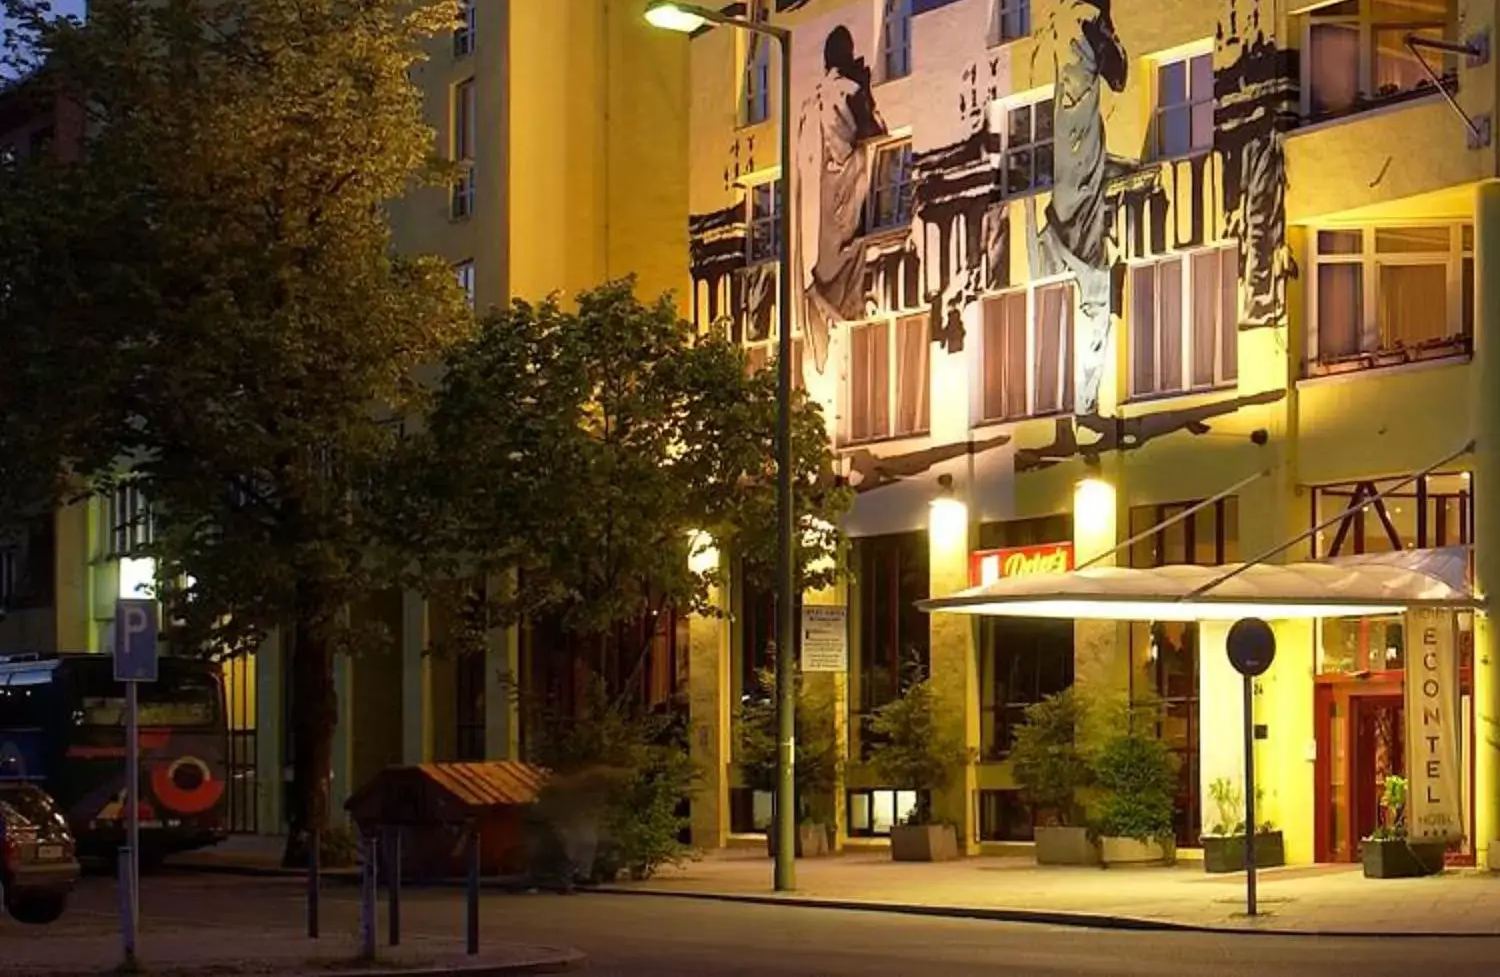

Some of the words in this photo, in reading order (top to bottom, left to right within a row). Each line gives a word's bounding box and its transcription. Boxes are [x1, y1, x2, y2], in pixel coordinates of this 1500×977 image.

[123, 606, 148, 654] P
[1423, 627, 1441, 805] ECONTEL
[1417, 812, 1454, 827] HOTEL
